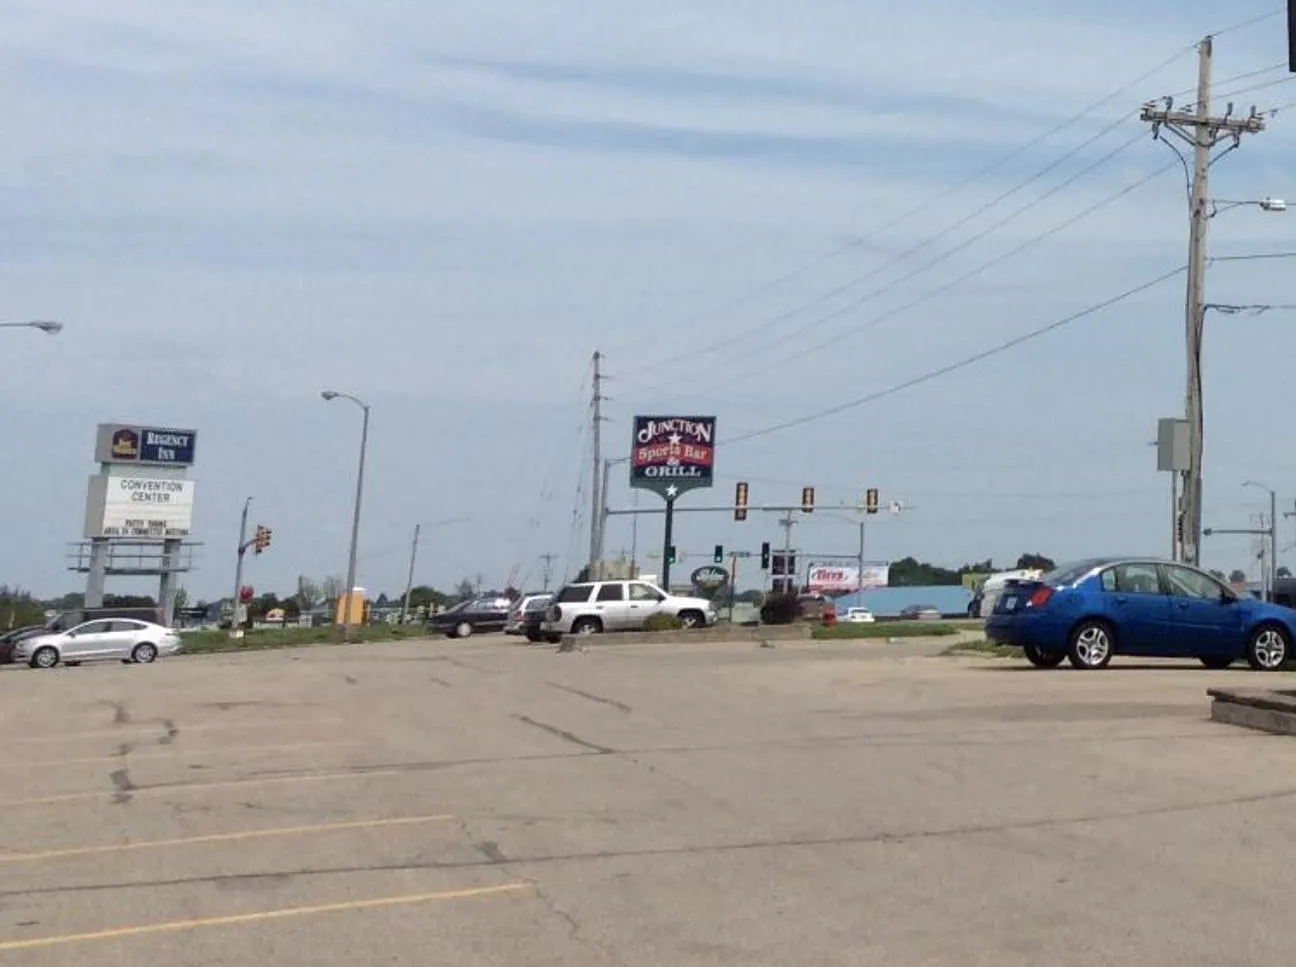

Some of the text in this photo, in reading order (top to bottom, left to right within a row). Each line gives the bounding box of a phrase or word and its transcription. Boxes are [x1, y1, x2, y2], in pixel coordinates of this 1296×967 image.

[638, 419, 712, 443] JUNCTION
[146, 431, 190, 447] REGENCY
[638, 444, 708, 461] Sports Bar
[644, 465, 702, 477] GRILL
[120, 479, 183, 493] CONVENTION
[131, 492, 171, 503] CENTER
